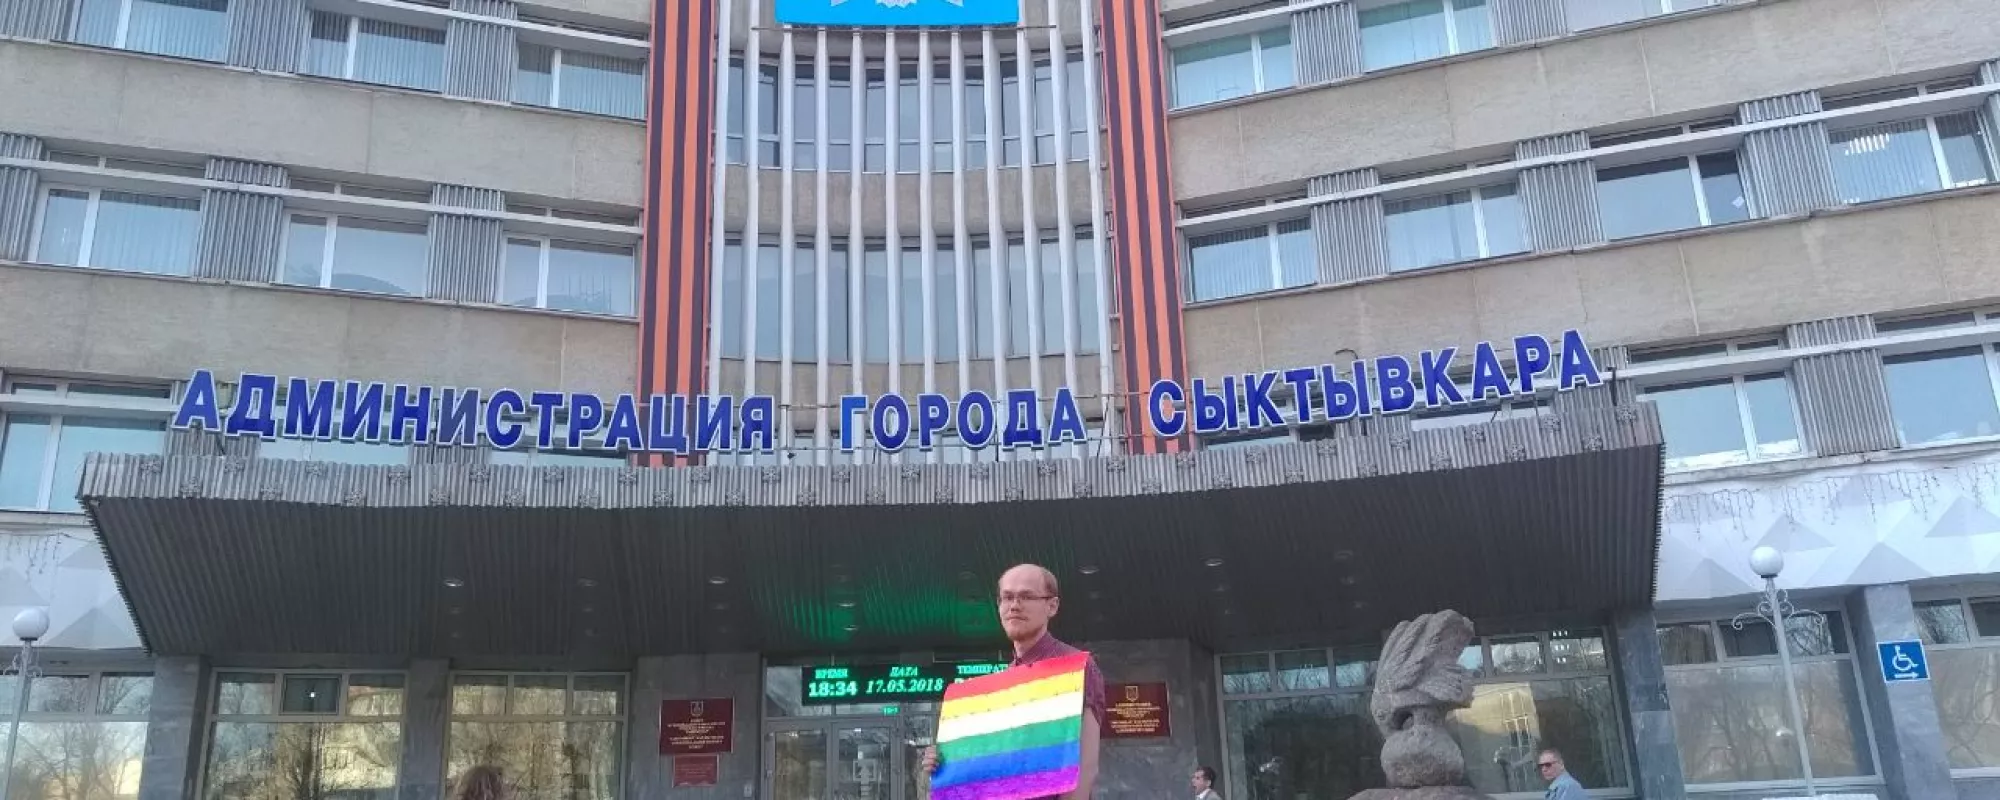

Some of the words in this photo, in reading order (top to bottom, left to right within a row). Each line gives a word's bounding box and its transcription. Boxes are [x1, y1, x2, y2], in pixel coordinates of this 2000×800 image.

[172, 369, 775, 454] АДМИНИСТРАЦИЯ
[841, 387, 1087, 450] ГОРОДА
[1148, 328, 1603, 437] СЫКТЫВКАРА
[889, 666, 918, 677] ДАТА
[808, 680, 857, 697] 18:34
[866, 678, 944, 694] 17.05.2018
